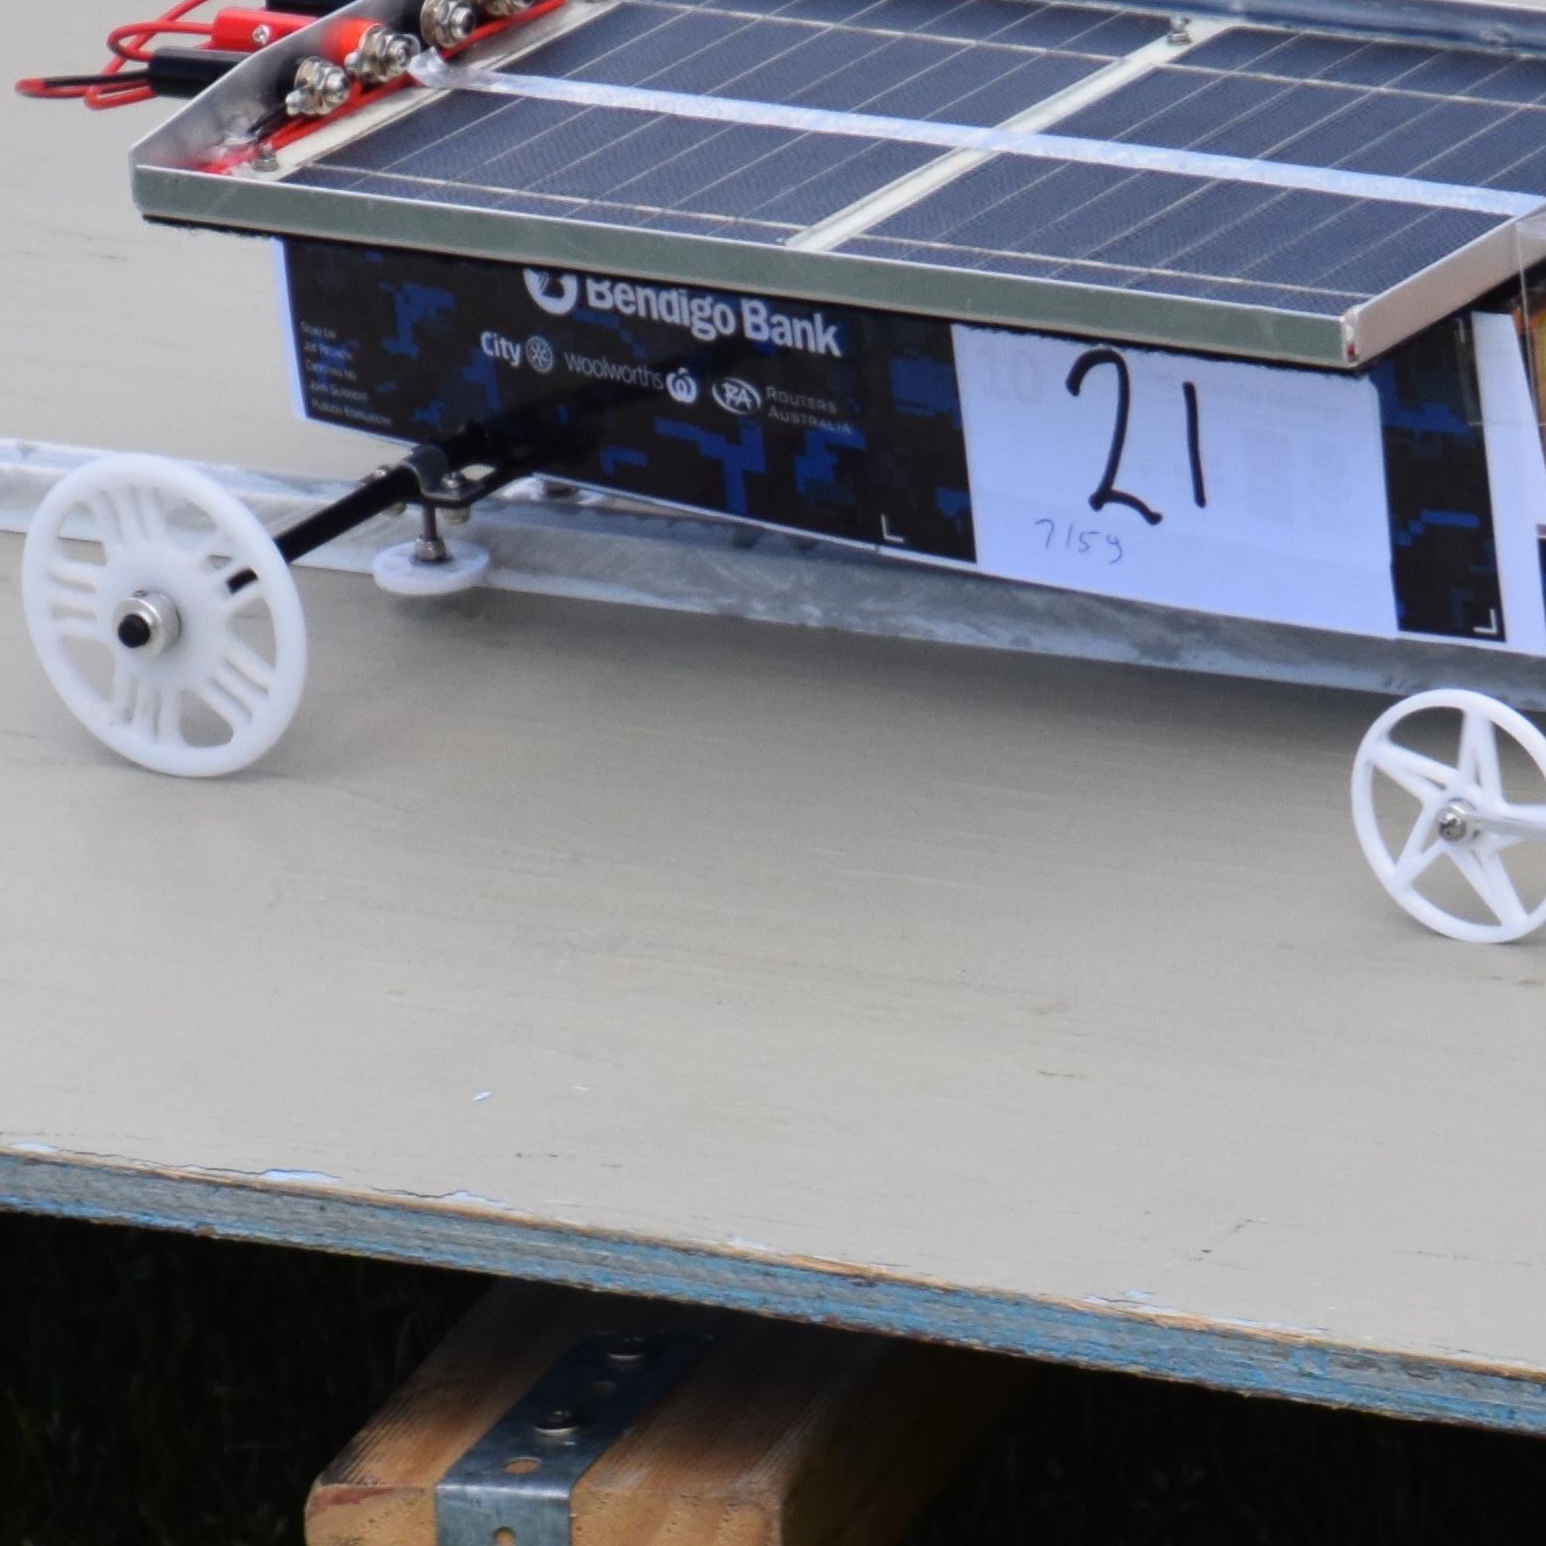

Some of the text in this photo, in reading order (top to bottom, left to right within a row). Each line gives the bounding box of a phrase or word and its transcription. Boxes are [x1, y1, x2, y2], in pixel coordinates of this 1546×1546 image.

[585, 277, 842, 357] Bendigo Bank
[480, 330, 521, 368] City
[564, 351, 664, 390] Woolworths
[1065, 348, 1207, 526] 21
